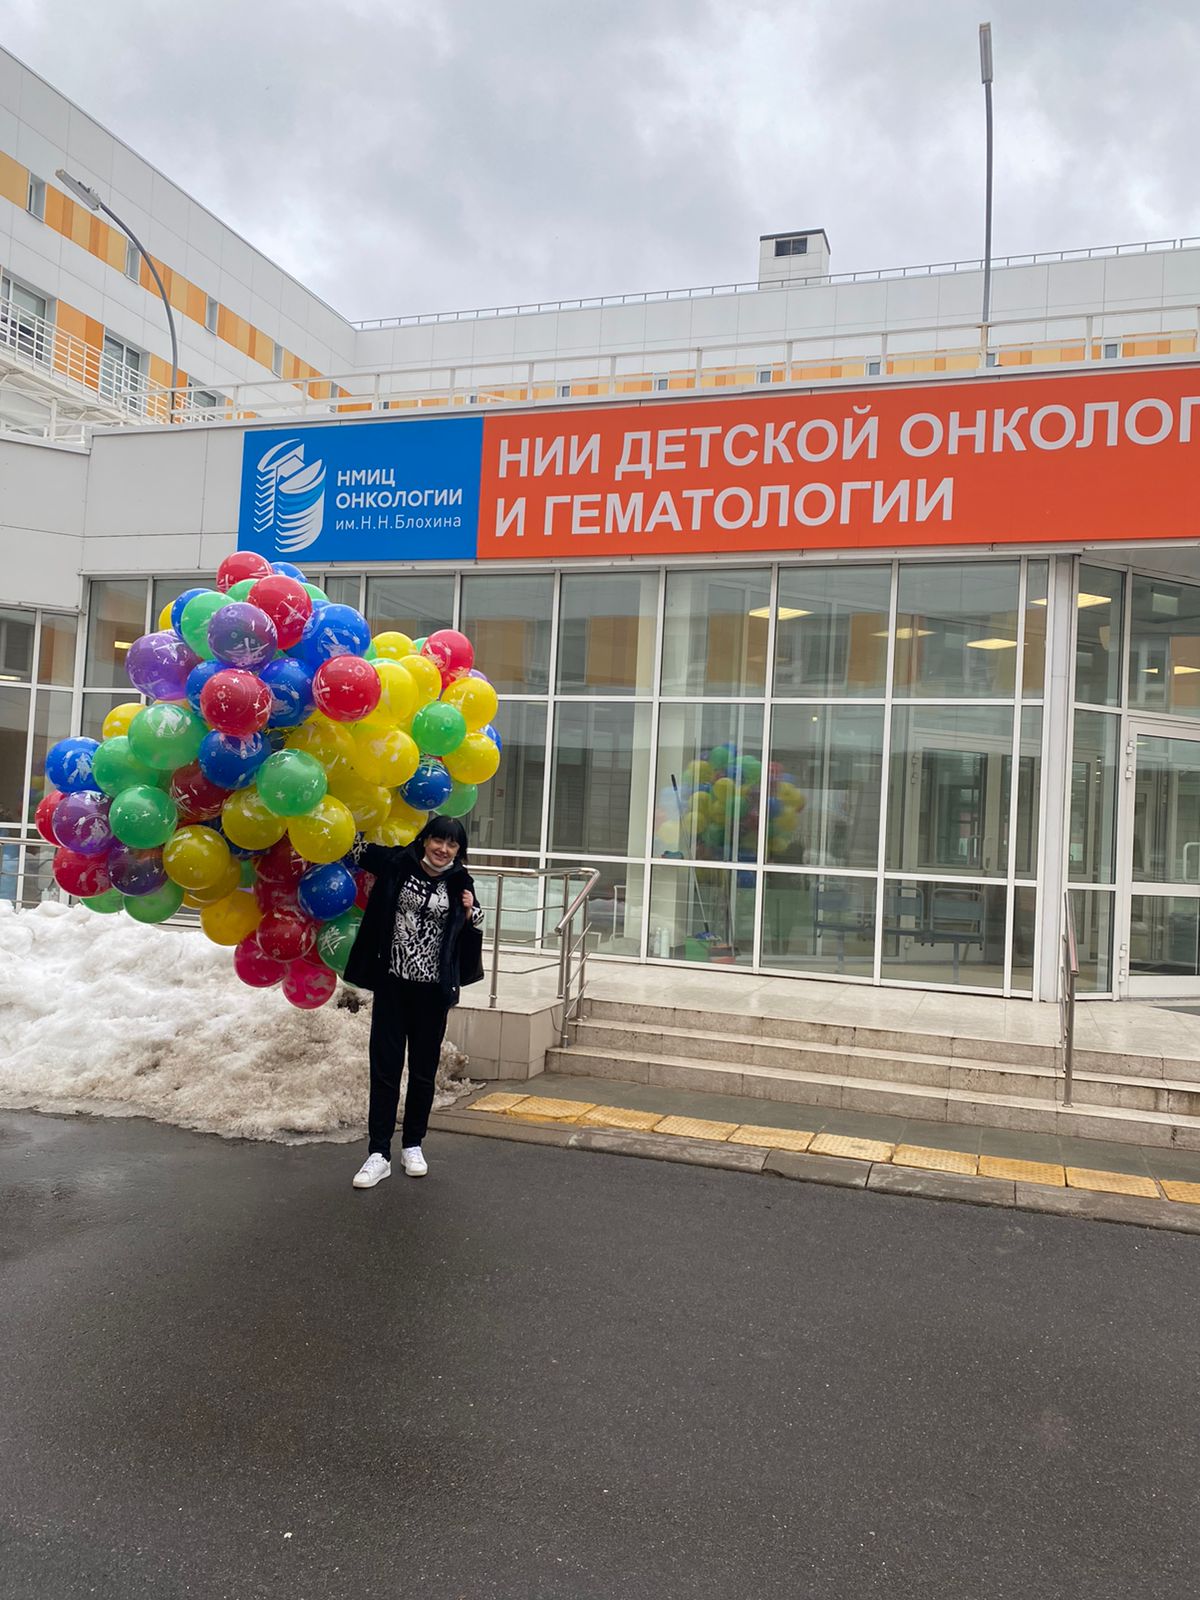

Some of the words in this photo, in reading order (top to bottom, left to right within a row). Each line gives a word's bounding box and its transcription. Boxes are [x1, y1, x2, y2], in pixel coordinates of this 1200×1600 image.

[498, 433, 601, 478] НИИ
[614, 404, 879, 481] ДЕТСКОЙ
[336, 468, 396, 487] НМИЦ
[335, 488, 463, 509] ОНКОЛОГИИ
[495, 497, 526, 537] И
[543, 477, 954, 536] ГЕМАТОЛОГИИ
